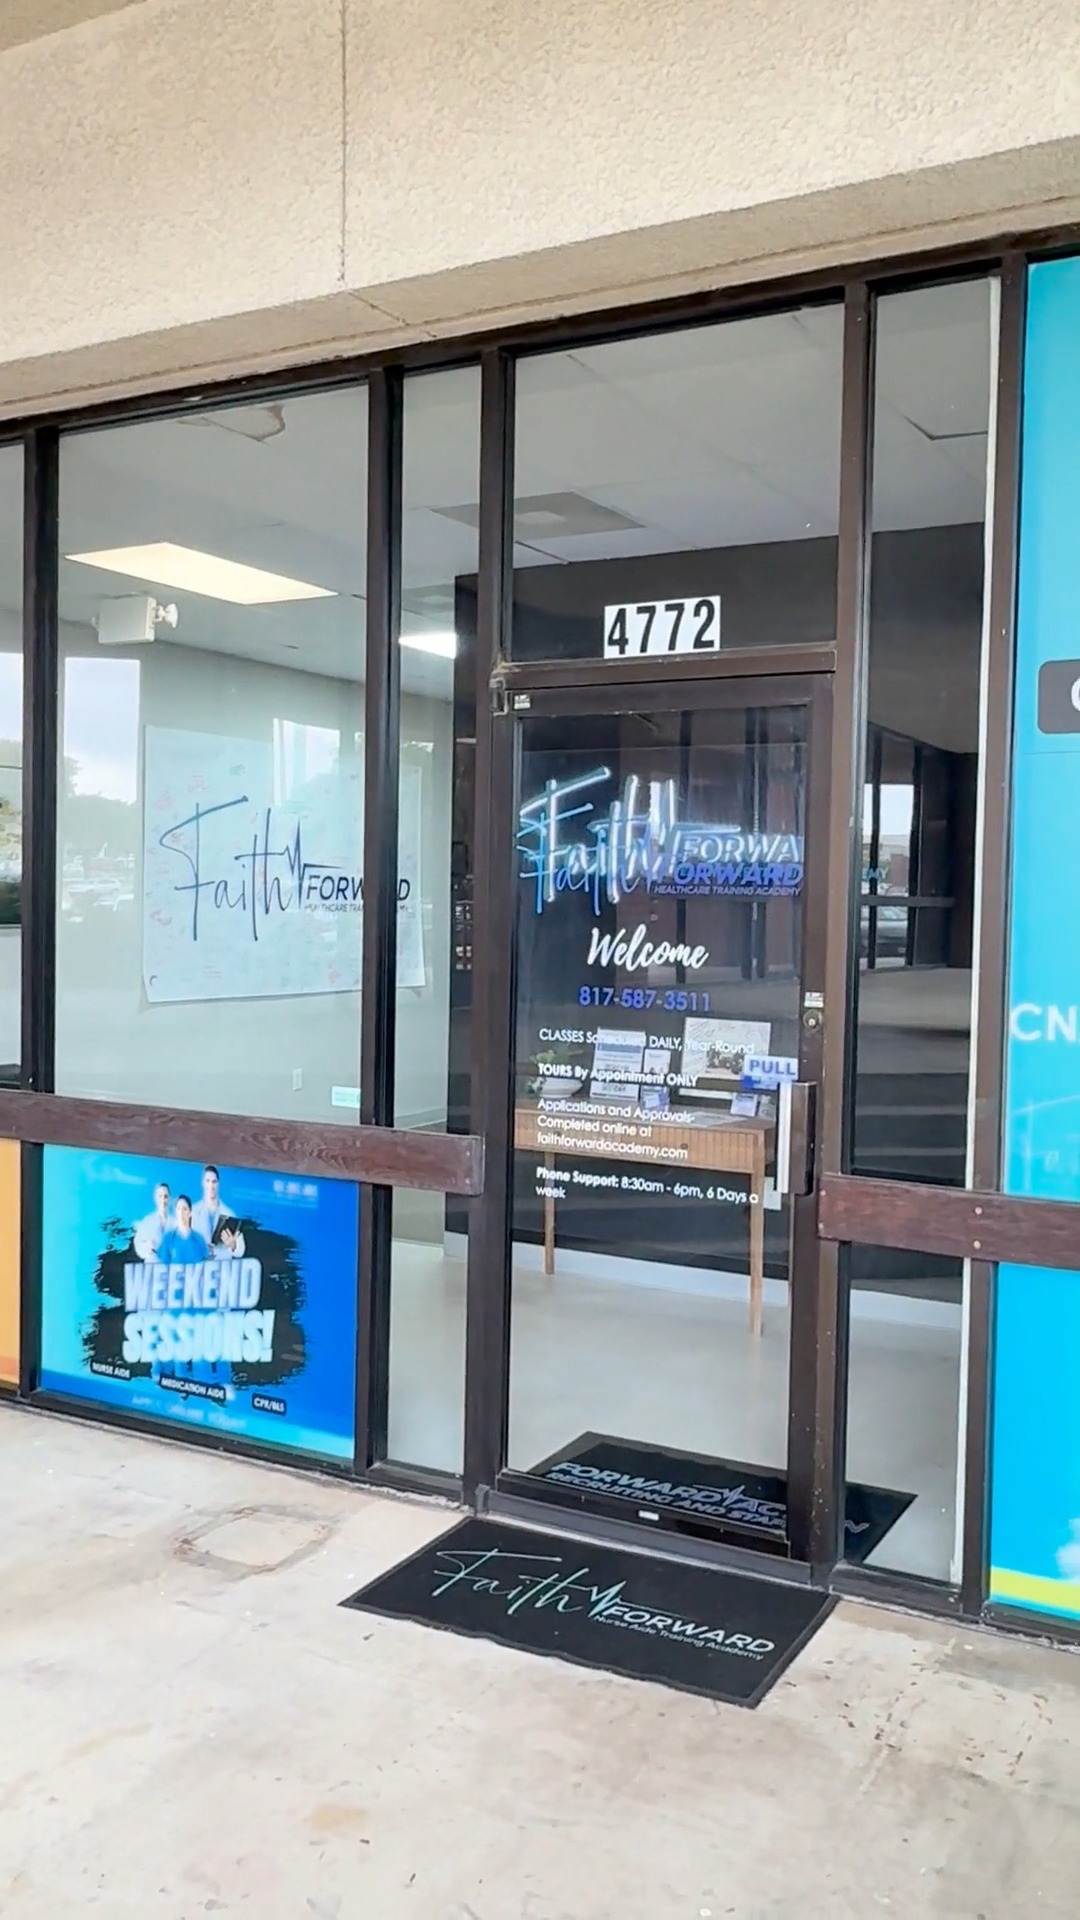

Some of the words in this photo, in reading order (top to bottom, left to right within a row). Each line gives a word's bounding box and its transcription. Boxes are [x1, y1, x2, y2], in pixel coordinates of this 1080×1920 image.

[607, 599, 716, 655] 4772
[160, 795, 293, 941] Faith
[307, 875, 410, 901] FORWD
[654, 885, 711, 895] HEALTHCARE
[712, 886, 755, 895] TRAINING
[755, 887, 801, 896] ACADEMY
[587, 923, 709, 971] Welcome
[579, 985, 710, 1012] 817-587-3511
[1009, 1003, 1080, 1042] CN
[539, 1028, 584, 1043] CLASSES
[649, 1036, 682, 1051] DAILY,
[538, 1063, 572, 1077] TOURS
[575, 1066, 588, 1080] By
[590, 1068, 665, 1084] Appointment
[667, 1073, 698, 1087] ONLY
[750, 1060, 796, 1075] PULL
[537, 1098, 605, 1115] Applications
[608, 1105, 631, 1118] and
[537, 1115, 600, 1132] Completed
[602, 1122, 636, 1134] online
[639, 1126, 652, 1137] at
[537, 1132, 688, 1159] faithforwardacademy.com
[535, 1185, 566, 1199] week
[536, 1166, 570, 1182] Phone
[572, 1170, 619, 1188] Support:
[621, 1176, 664, 1193] 8:30am
[674, 1182, 703, 1199] 6pm,
[706, 1188, 715, 1200] 6
[717, 1187, 747, 1205] Days
[749, 1193, 759, 1204] a
[124, 1257, 262, 1312] WEEKEND
[122, 1309, 276, 1363] SESSIONS!
[92, 1362, 113, 1375] NURSE
[114, 1367, 130, 1379] AIDE
[161, 1377, 206, 1394] MEDICATION
[207, 1386, 224, 1400] AIDE
[546, 1472, 673, 1505] RECRUITING
[672, 1498, 726, 1516] AND
[551, 1462, 723, 1502] FORWARD
[432, 1548, 590, 1616] Faith
[602, 1605, 775, 1653] FORWARD
[594, 1615, 628, 1628] Nurse
[629, 1624, 657, 1635] Aide
[660, 1630, 705, 1648] Training
[706, 1641, 765, 1661] Academy
